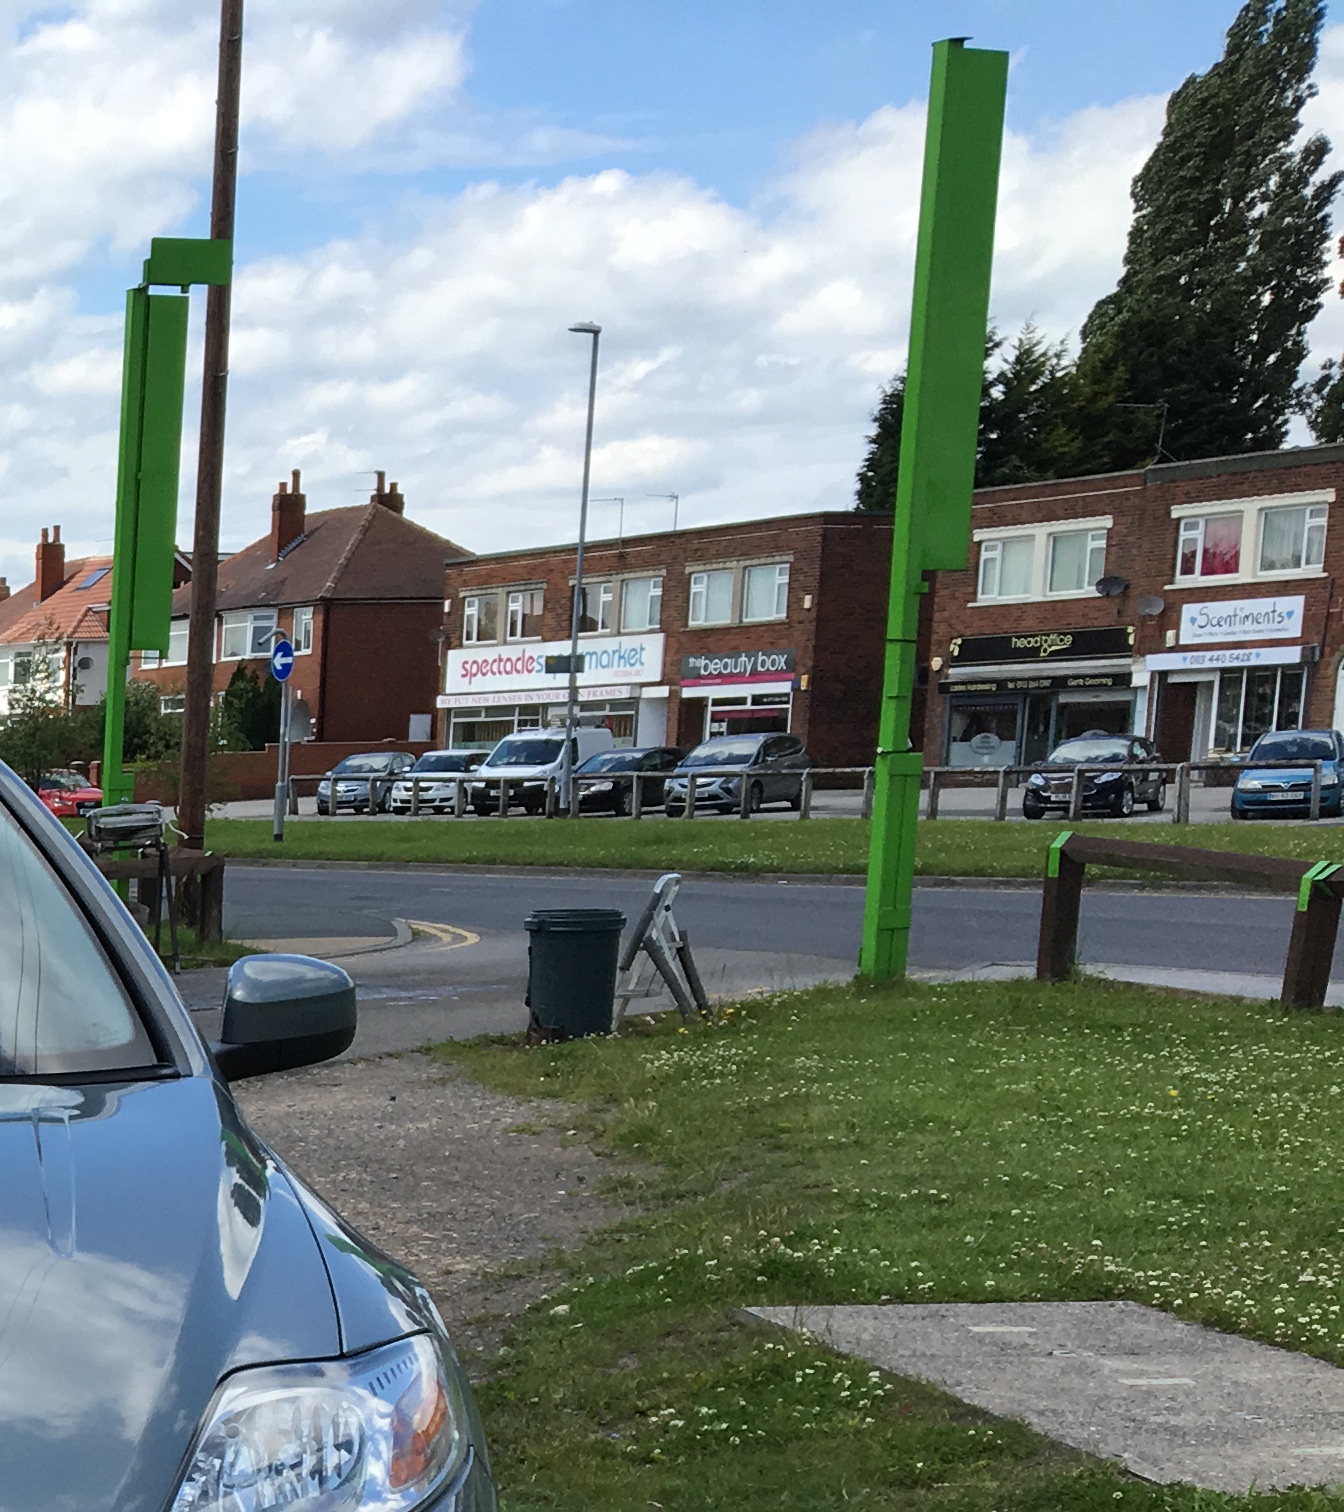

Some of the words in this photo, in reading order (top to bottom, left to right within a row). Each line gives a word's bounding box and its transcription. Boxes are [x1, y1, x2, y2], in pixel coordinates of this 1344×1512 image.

[1198, 601, 1285, 629] Scentiments
[1012, 635, 1041, 648] head
[700, 653, 755, 677] beauty
[757, 651, 788, 672] box
[1209, 653, 1226, 664] 440
[471, 695, 490, 705] NEW
[492, 693, 522, 703] LENSES
[524, 692, 535, 702] IN
[537, 691, 561, 702] YOUR
[587, 687, 623, 698] FRAMES
